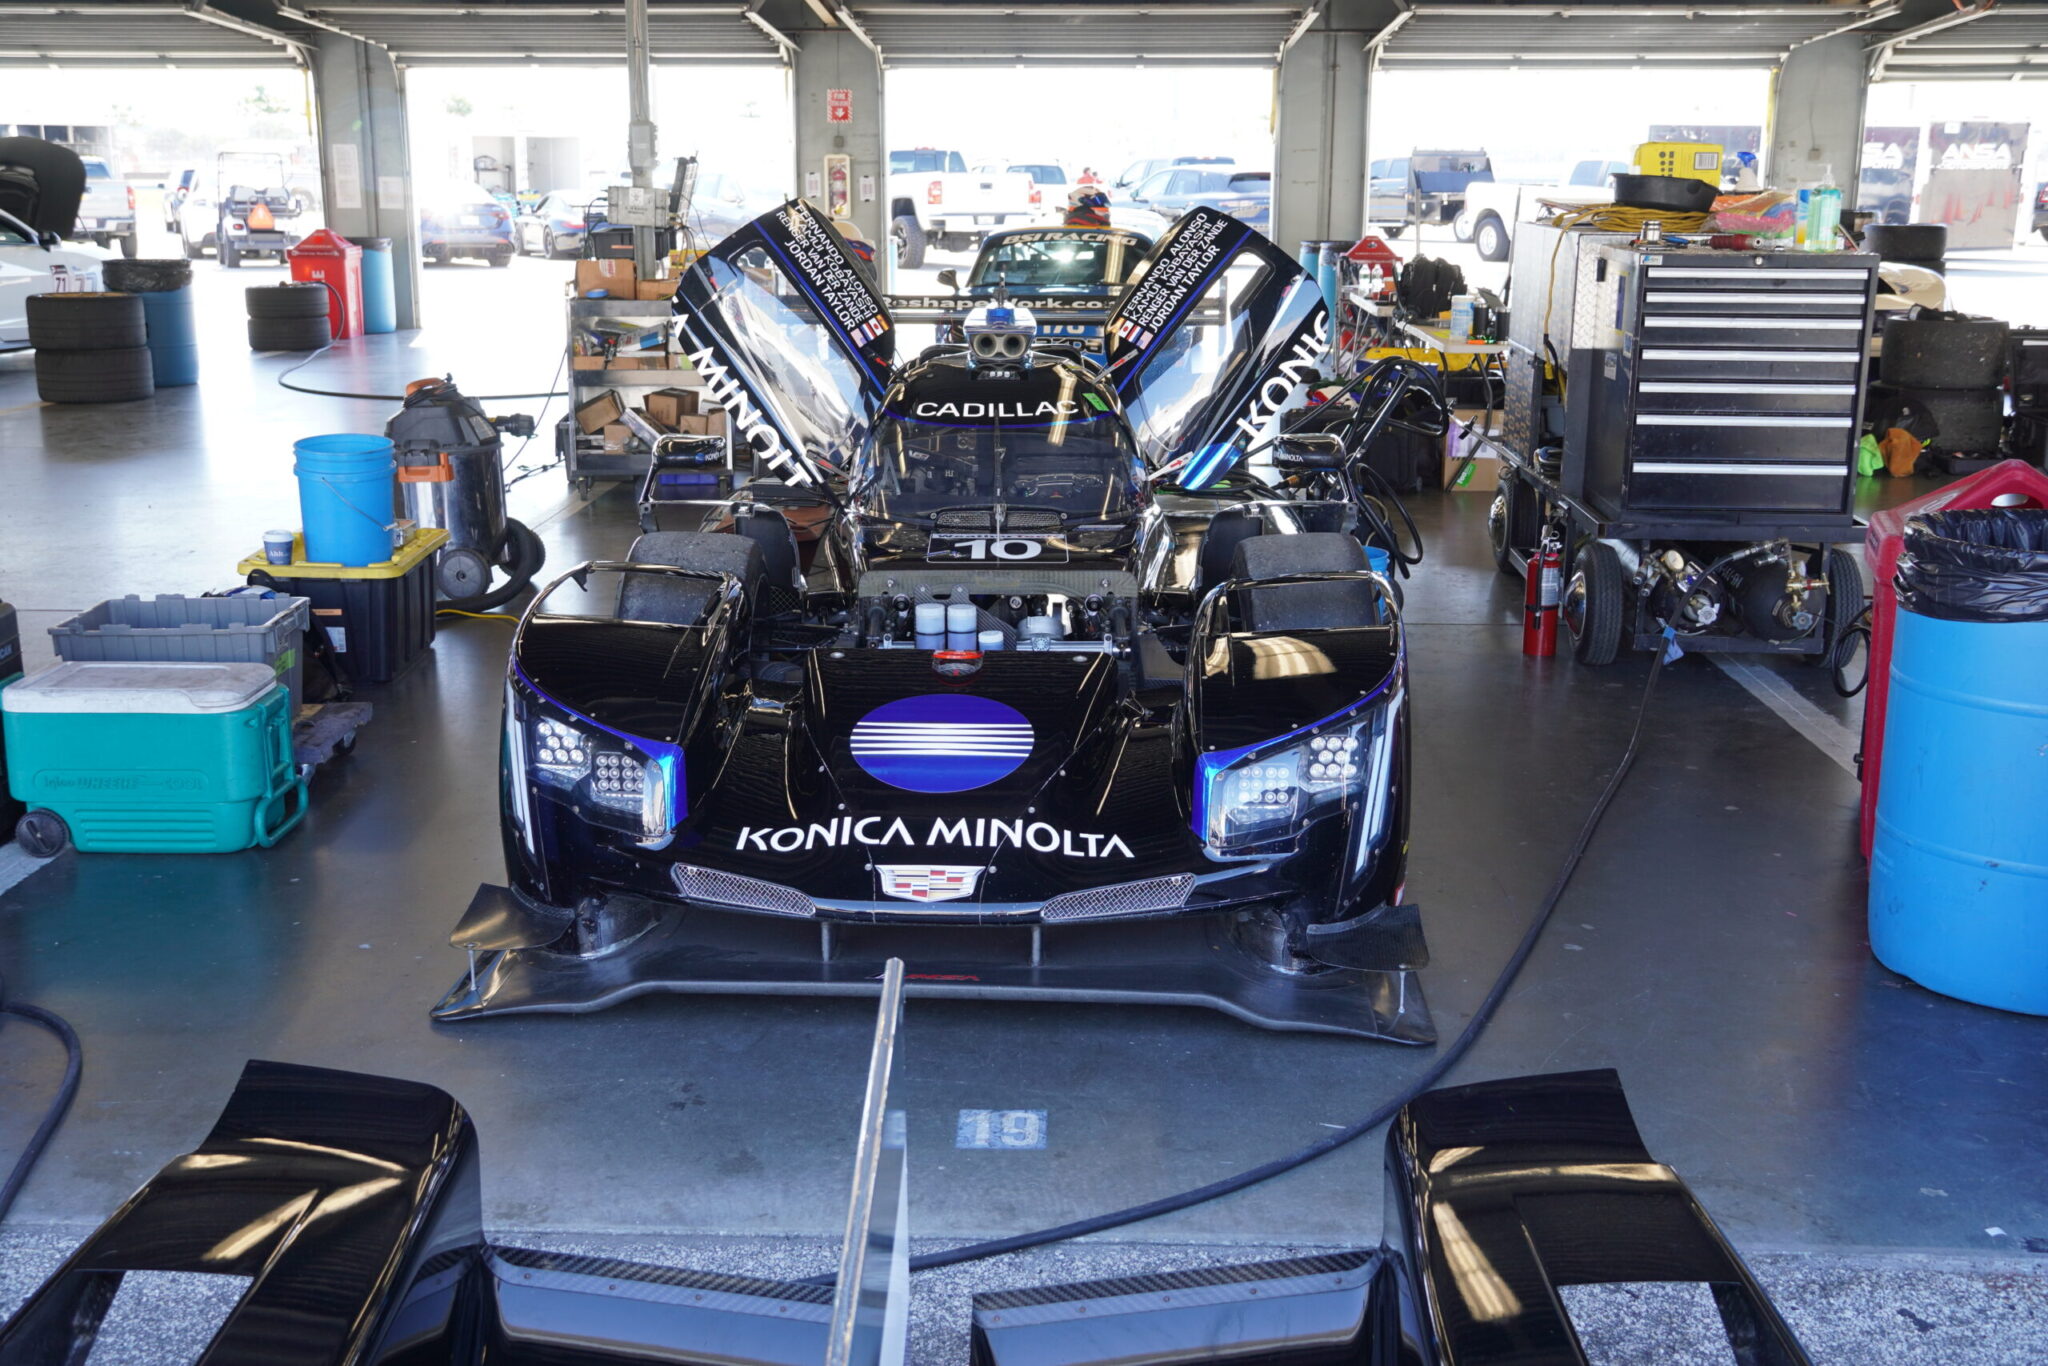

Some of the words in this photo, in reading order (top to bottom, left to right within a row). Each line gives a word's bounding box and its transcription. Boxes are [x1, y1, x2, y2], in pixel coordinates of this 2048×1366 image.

[775, 210, 810, 249] RENGER
[807, 247, 824, 269] VAN
[823, 269, 840, 290] DER
[837, 289, 866, 324] ZANDE
[794, 204, 845, 266] FERNANDO
[843, 268, 879, 314] ALONSO
[1002, 232, 1043, 246] BSI
[1045, 231, 1138, 247] RACING
[1122, 257, 1170, 317] FERNANDO
[1169, 212, 1208, 256] ALONSO
[1129, 283, 1162, 321] KAMUI
[1161, 222, 1212, 281] KOBAYASHI
[1138, 288, 1171, 327] RENGER
[1166, 267, 1187, 288] VAN
[1181, 248, 1202, 269] DER
[1198, 218, 1229, 251] ZANDE
[784, 239, 825, 287] JORDAN
[820, 285, 857, 331] TAYLOR
[823, 254, 873, 320] KOBAYASHI
[1149, 286, 1188, 333] JORDAN
[1181, 244, 1221, 286] TAYLOR
[687, 346, 813, 488] MINOLT
[916, 401, 1079, 418] CADILLAC
[954, 539, 1042, 560] 10
[736, 816, 915, 853] KONICA
[926, 817, 1136, 858] MINOLTA
[965, 1112, 1039, 1146] 19
